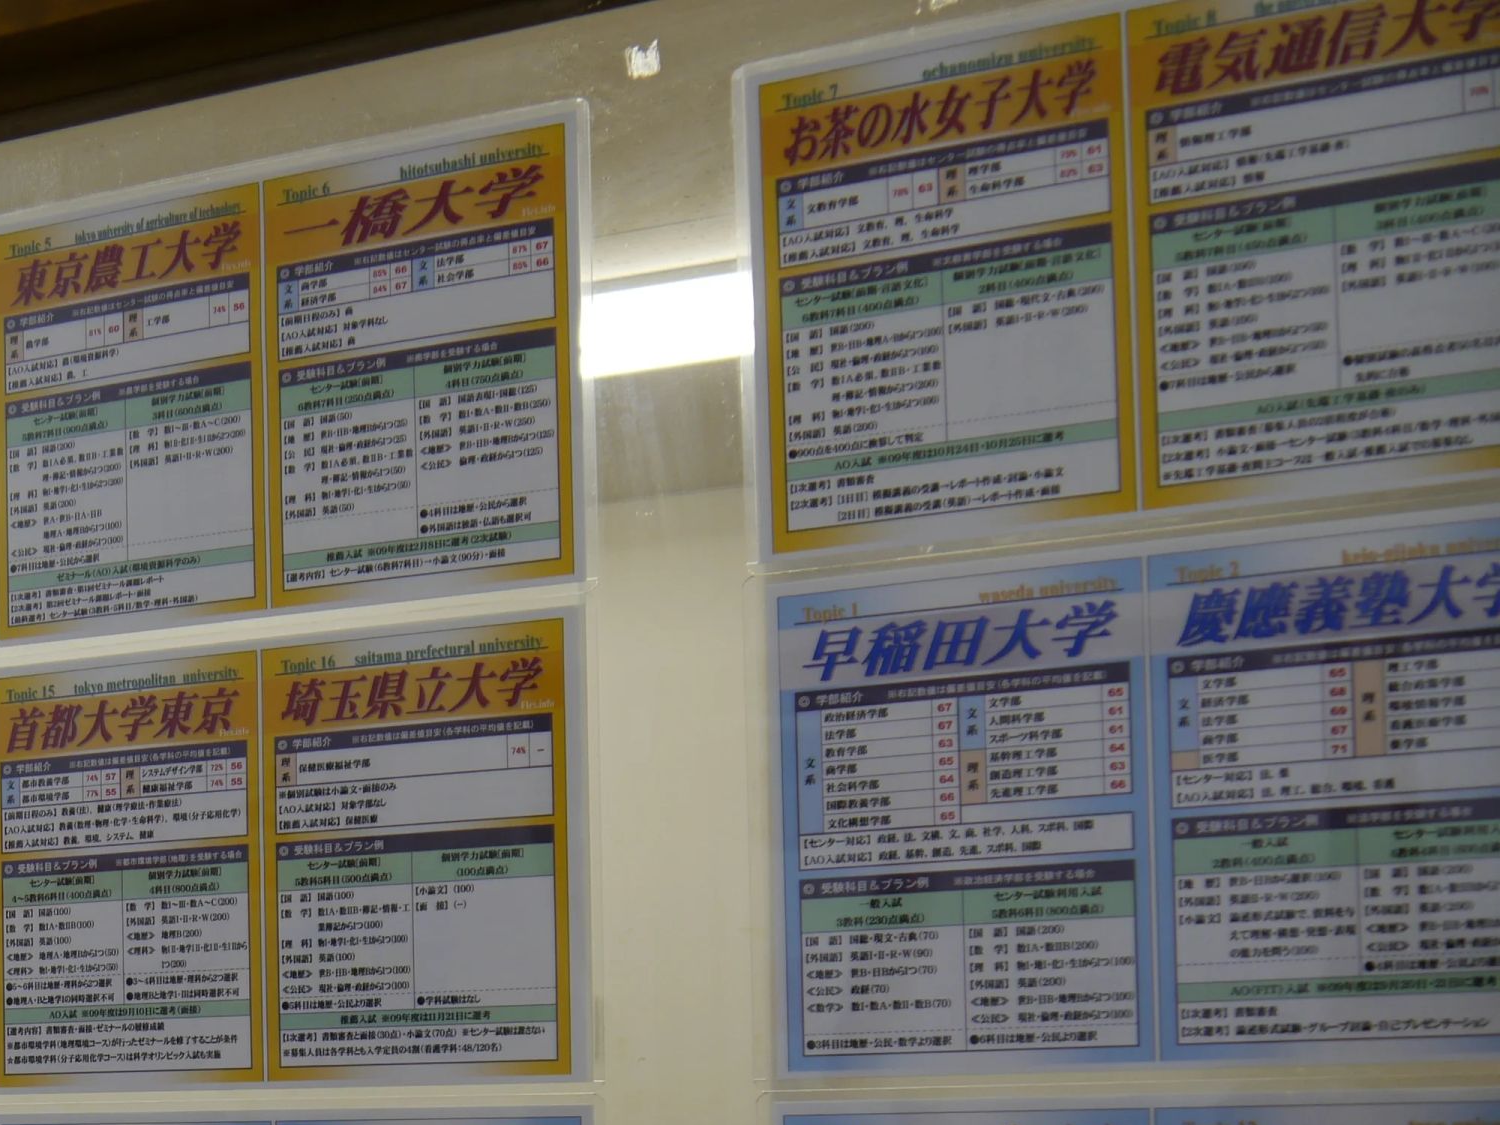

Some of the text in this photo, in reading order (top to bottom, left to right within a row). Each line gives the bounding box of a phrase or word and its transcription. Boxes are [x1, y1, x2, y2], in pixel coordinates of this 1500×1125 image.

[784, 58, 1097, 165] お茶の水女子大学
[282, 141, 544, 202] Topic 6 hitotsubashi university
[284, 165, 544, 246] 一橋大学
[10, 221, 241, 308] 東京農工大学
[281, 635, 544, 674] Topic 16 saitama prefectural university
[801, 601, 1118, 682] 早稲田大学
[6, 666, 238, 703] Topic 15 tokyo metropolitan university
[282, 658, 544, 726] 埼玉県立大学
[937, 703, 952, 712] 67
[6, 689, 238, 754] 首都大学東京
